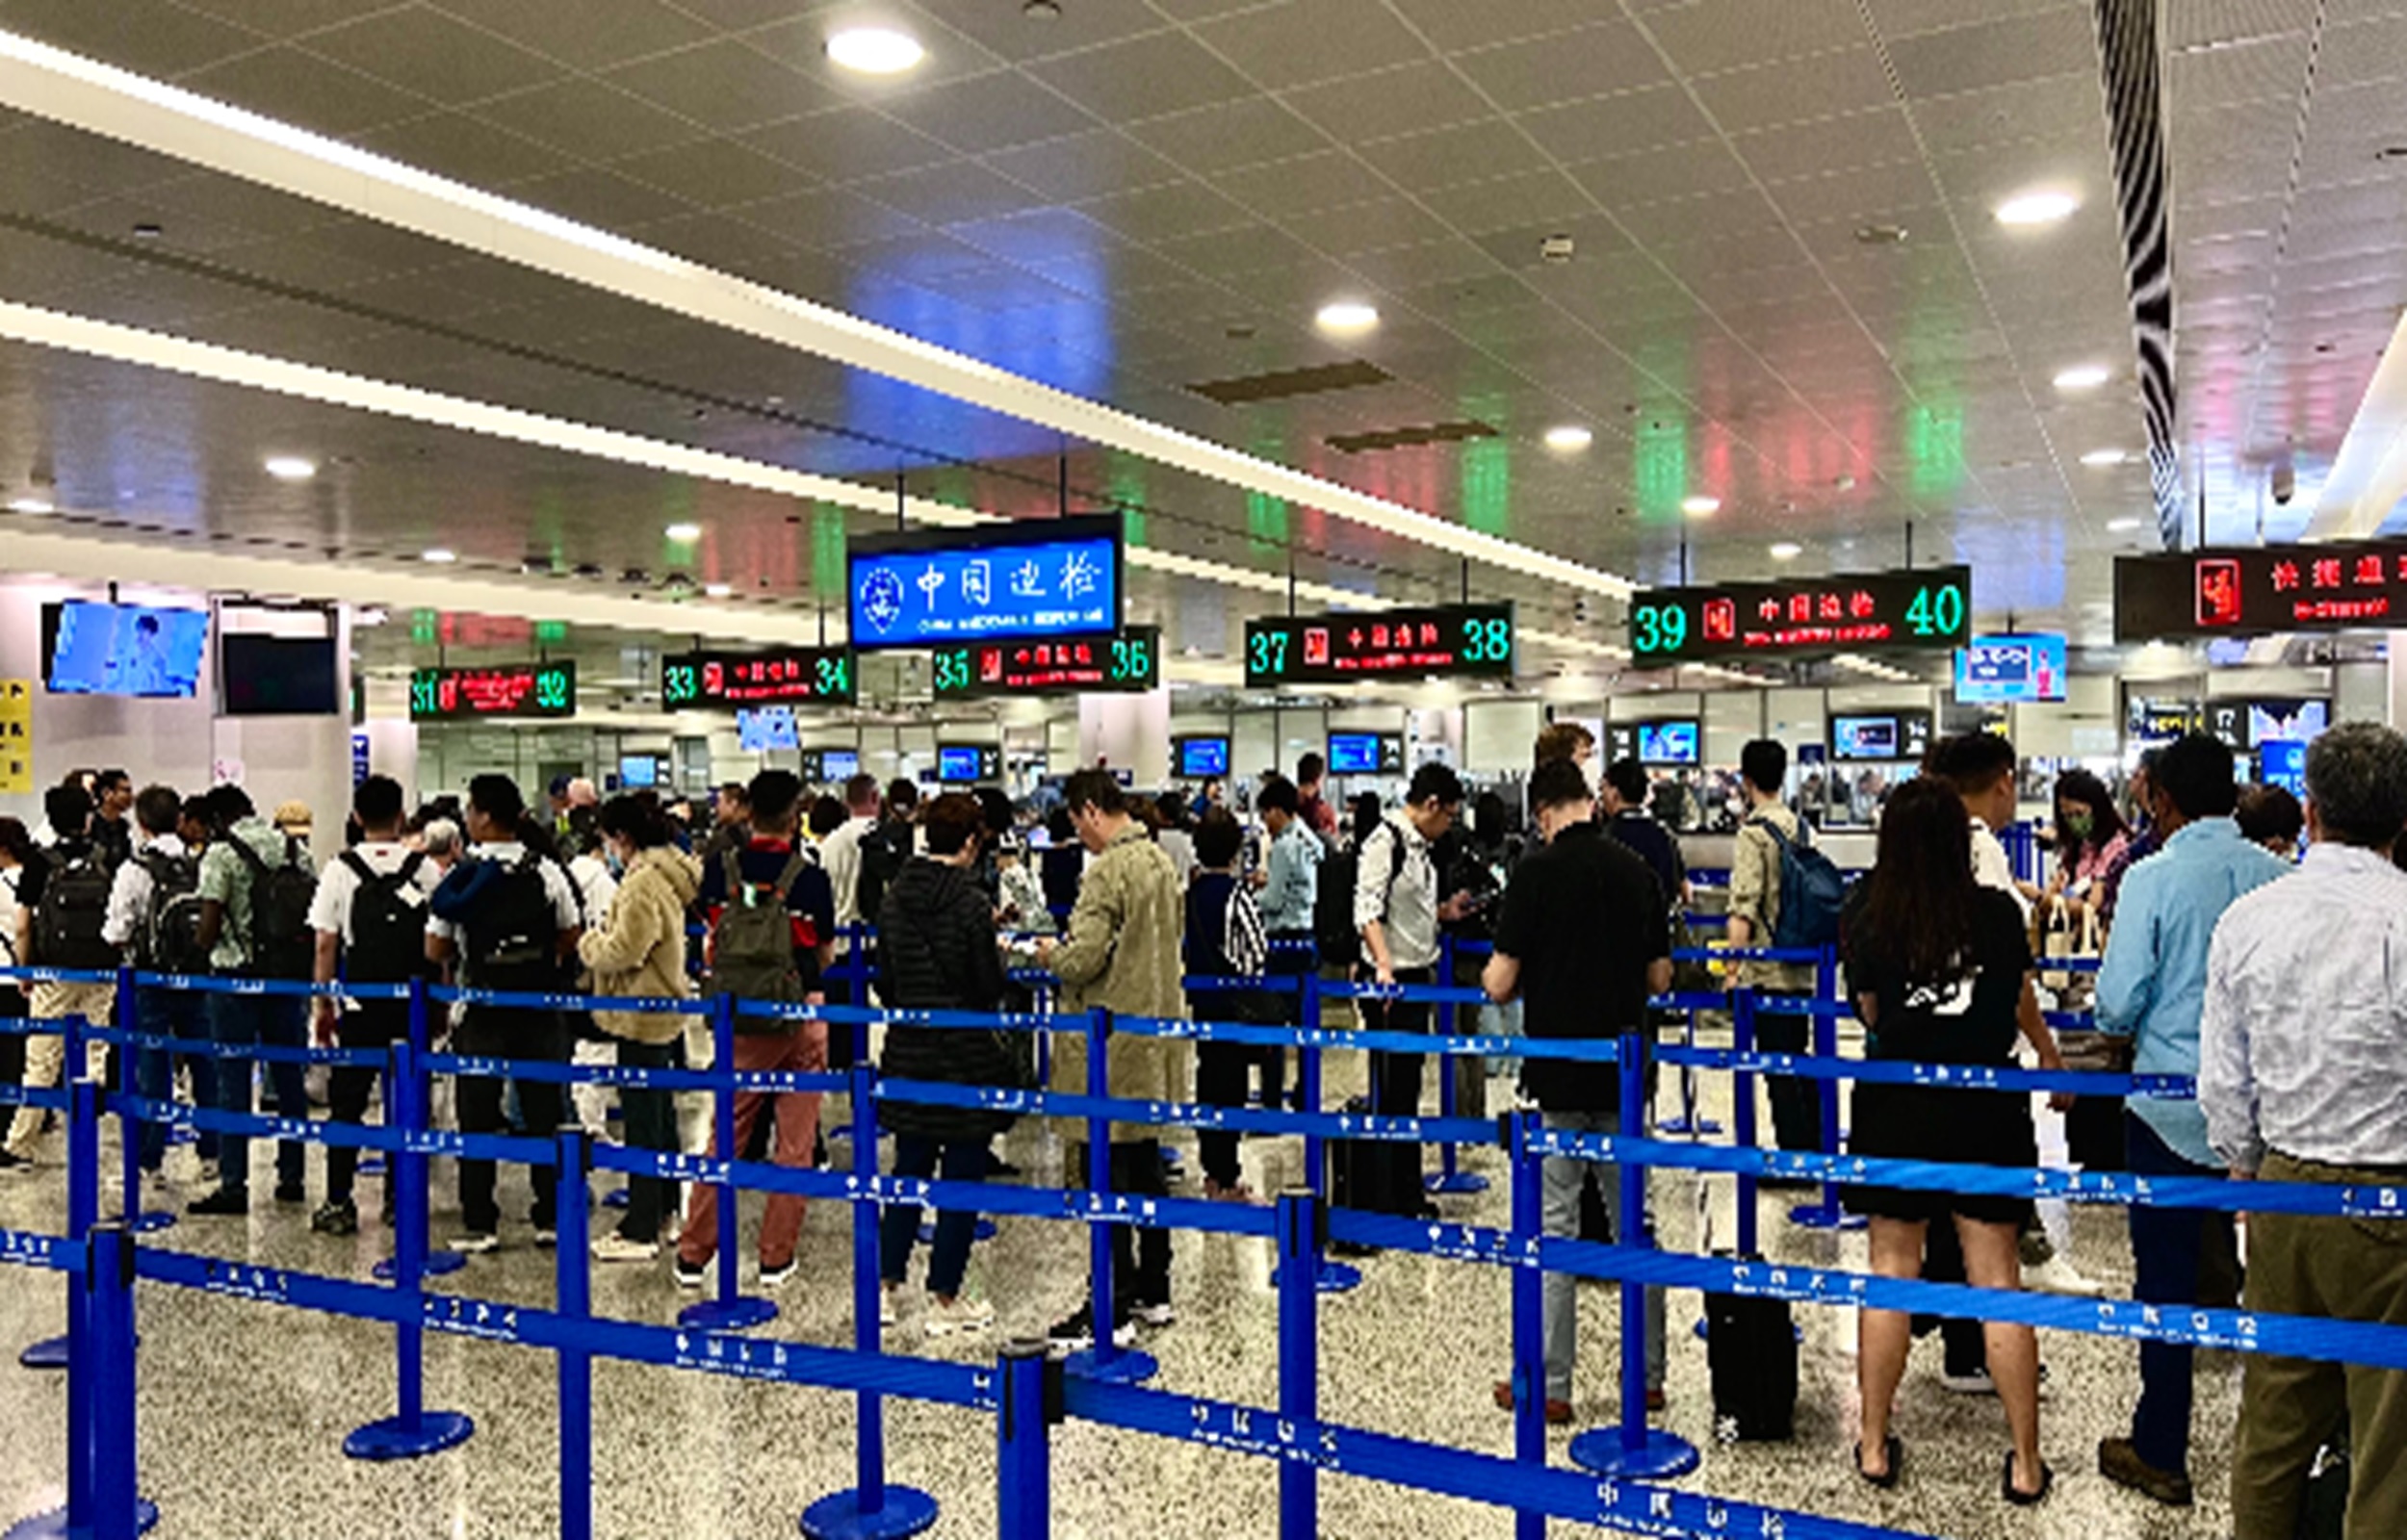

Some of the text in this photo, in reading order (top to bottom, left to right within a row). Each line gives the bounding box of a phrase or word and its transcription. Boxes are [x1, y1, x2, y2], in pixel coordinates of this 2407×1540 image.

[1636, 605, 1687, 653] 39
[1904, 585, 1964, 635] 40
[1111, 640, 1150, 680] 36
[1251, 631, 1289, 673] 37
[1462, 619, 1510, 661] 38
[666, 666, 697, 703] 33
[815, 658, 848, 695] 34
[935, 649, 970, 690] 35
